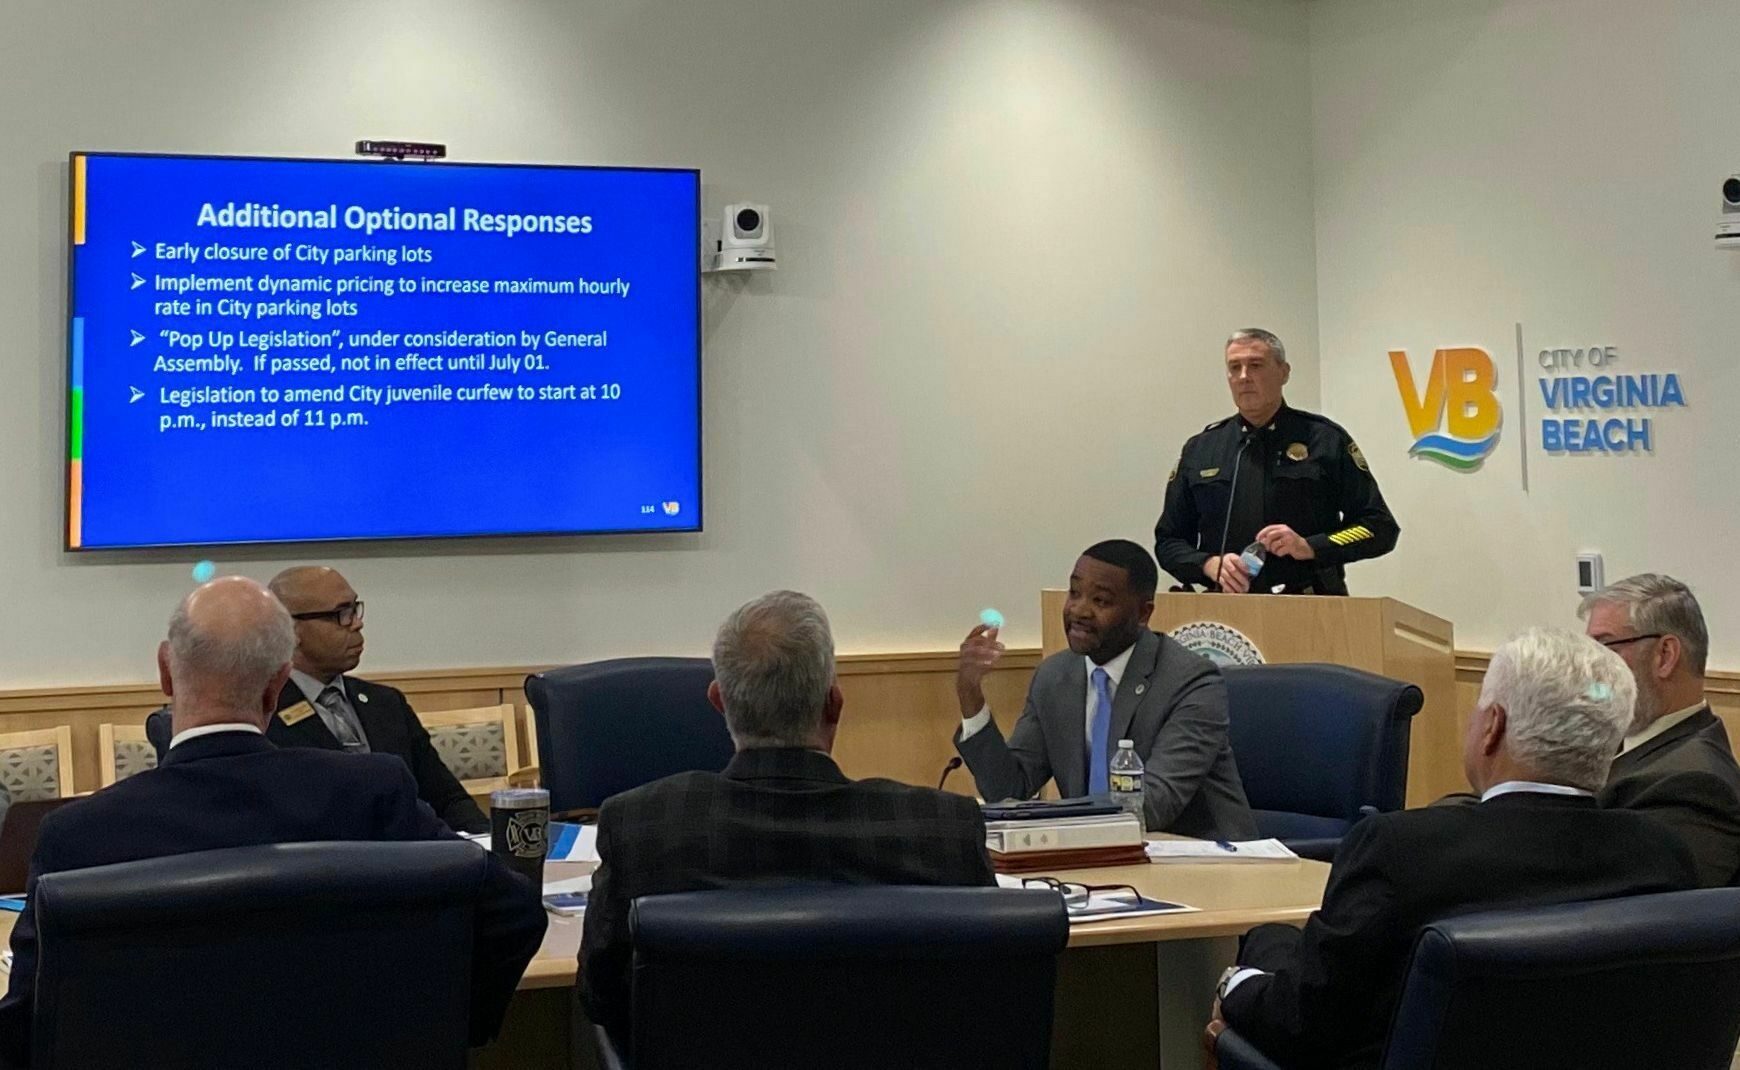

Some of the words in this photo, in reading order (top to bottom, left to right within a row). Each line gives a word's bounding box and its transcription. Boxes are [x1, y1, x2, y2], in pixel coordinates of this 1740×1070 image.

[197, 203, 337, 228] Additional
[345, 206, 456, 234] Optional
[464, 209, 592, 237] Responses
[156, 243, 199, 263] Early
[205, 243, 267, 260] closure
[273, 244, 291, 260] of
[296, 245, 329, 264] City
[334, 245, 396, 265] parking
[402, 246, 432, 262] lots
[156, 274, 253, 294] Implement
[258, 275, 332, 295] dynamic
[337, 276, 394, 296] pricing
[399, 278, 416, 292] to
[422, 277, 489, 292] increase
[495, 278, 574, 293] maximum
[580, 278, 629, 297] hourly
[155, 300, 190, 315] rate
[197, 299, 211, 314] in
[218, 299, 251, 319] City
[257, 299, 321, 319] parking
[327, 299, 357, 315] lots
[160, 330, 202, 350] “Pop
[209, 331, 233, 350] Up
[240, 330, 343, 350] Legislation”,
[350, 330, 399, 346] under
[404, 331, 515, 346] consideration
[522, 331, 540, 350] by
[545, 331, 606, 346] General
[154, 355, 242, 375] Assembly.
[255, 354, 266, 370] If
[272, 354, 335, 374] passed,
[342, 356, 370, 370] not
[376, 355, 390, 370] in
[396, 354, 443, 370] effect
[448, 354, 484, 369] until
[489, 354, 520, 373] July
[525, 354, 549, 369] 01.
[1539, 349, 1583, 370] CITY
[1588, 346, 1618, 366] OF
[161, 386, 255, 407] Legislation
[261, 387, 279, 402] to
[284, 385, 344, 402] amend
[350, 386, 382, 405] City
[386, 385, 452, 405] juvenile
[457, 384, 513, 400] curfew
[518, 385, 534, 399] to
[539, 385, 576, 399] start
[581, 385, 596, 399] at
[602, 384, 620, 399] 10
[1388, 347, 1502, 438] VB
[1539, 373, 1685, 408] VIRGINIA
[161, 415, 205, 432] p.m.,
[212, 410, 275, 427] instead
[281, 409, 299, 426] of
[305, 410, 324, 425] 11
[331, 413, 368, 429] p.m.
[1542, 418, 1651, 451] BEACH
